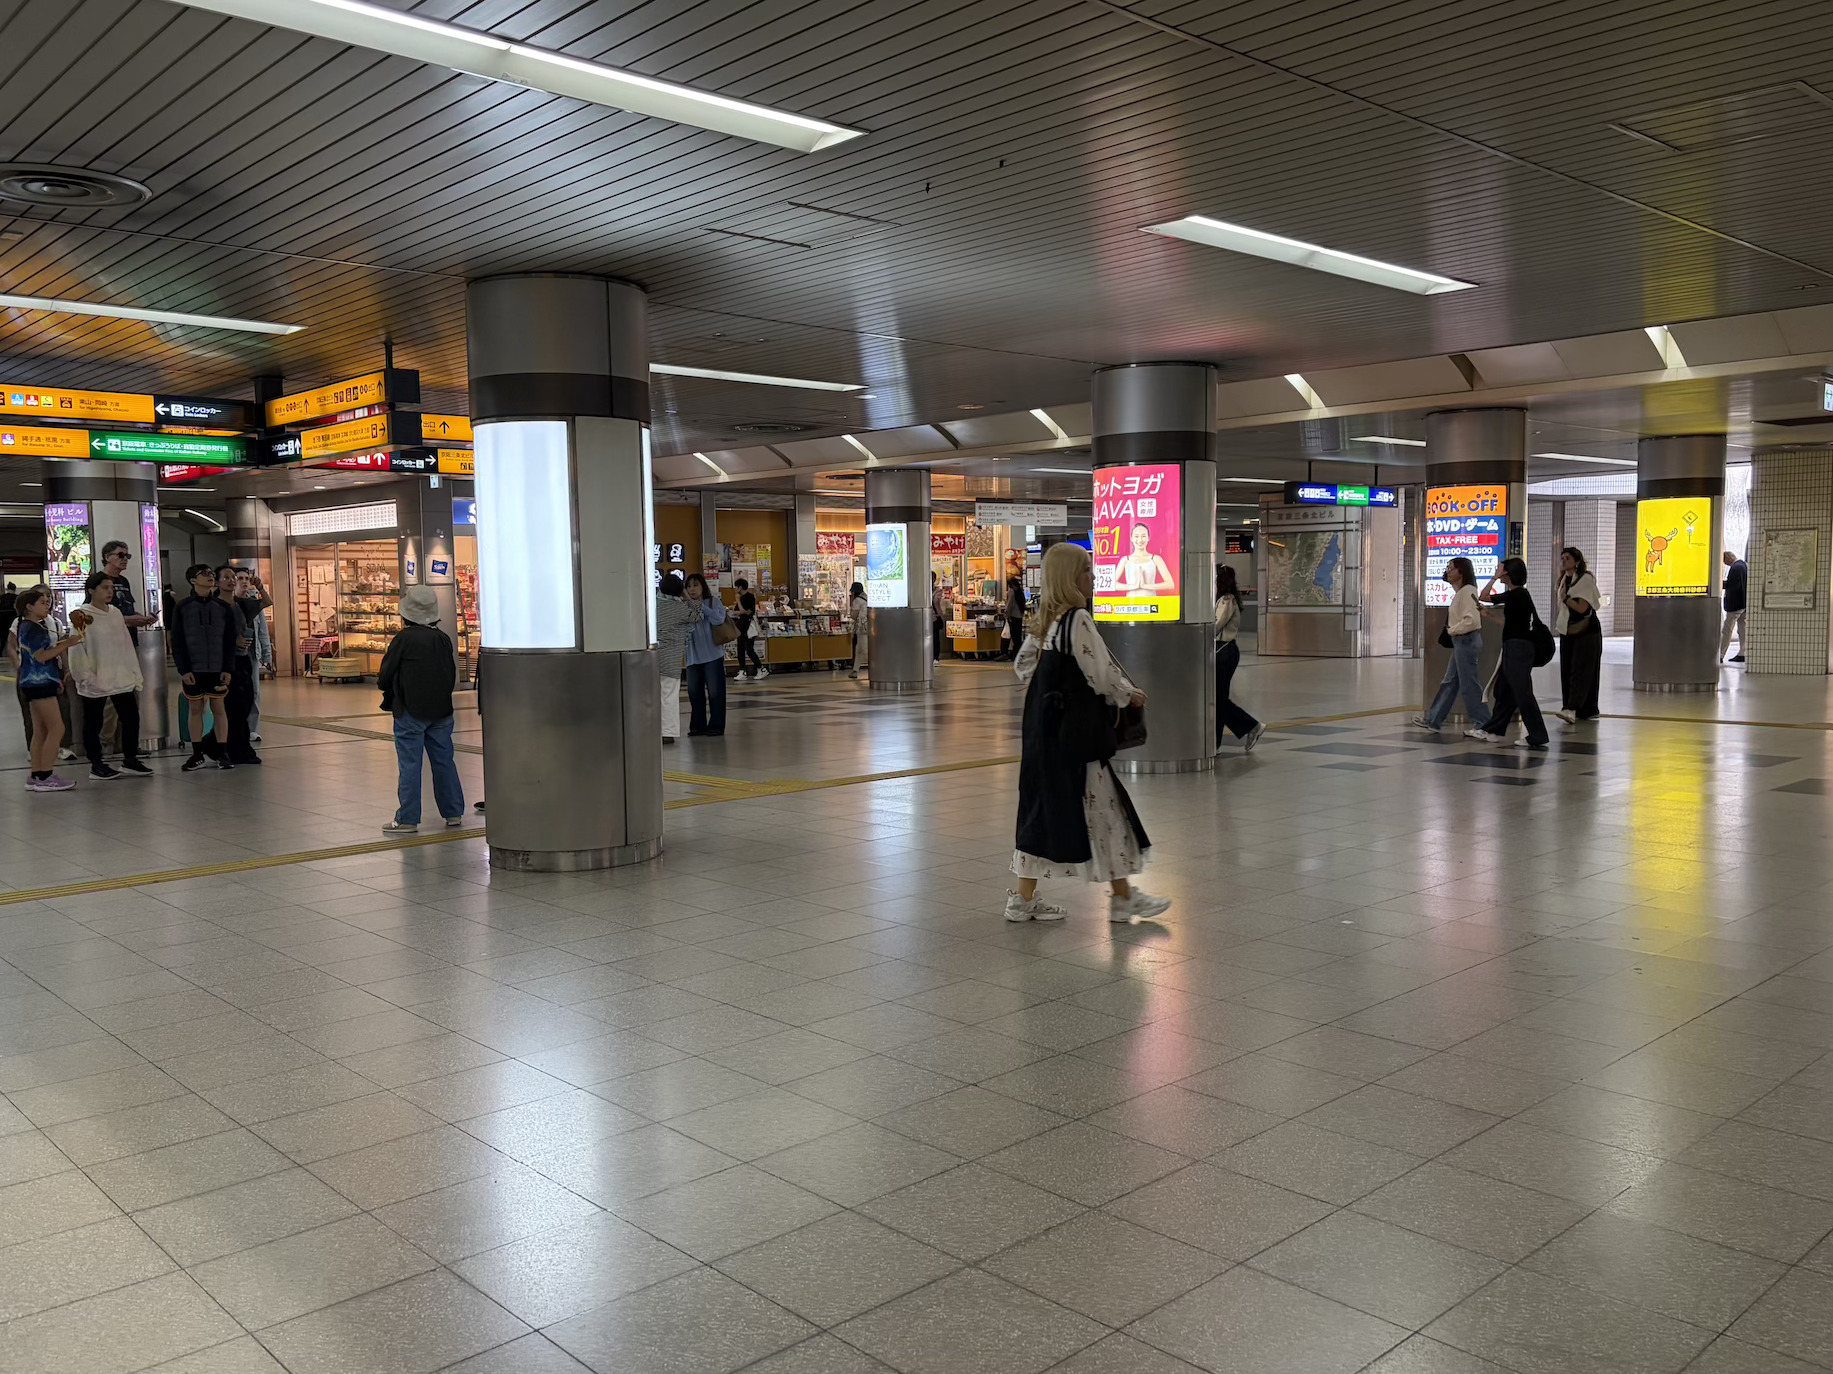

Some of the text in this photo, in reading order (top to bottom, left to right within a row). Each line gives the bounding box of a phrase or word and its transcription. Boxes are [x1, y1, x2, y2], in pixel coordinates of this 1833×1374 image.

[184, 406, 222, 414] コインロッカー
[1435, 536, 1478, 545] TAX-FREE
